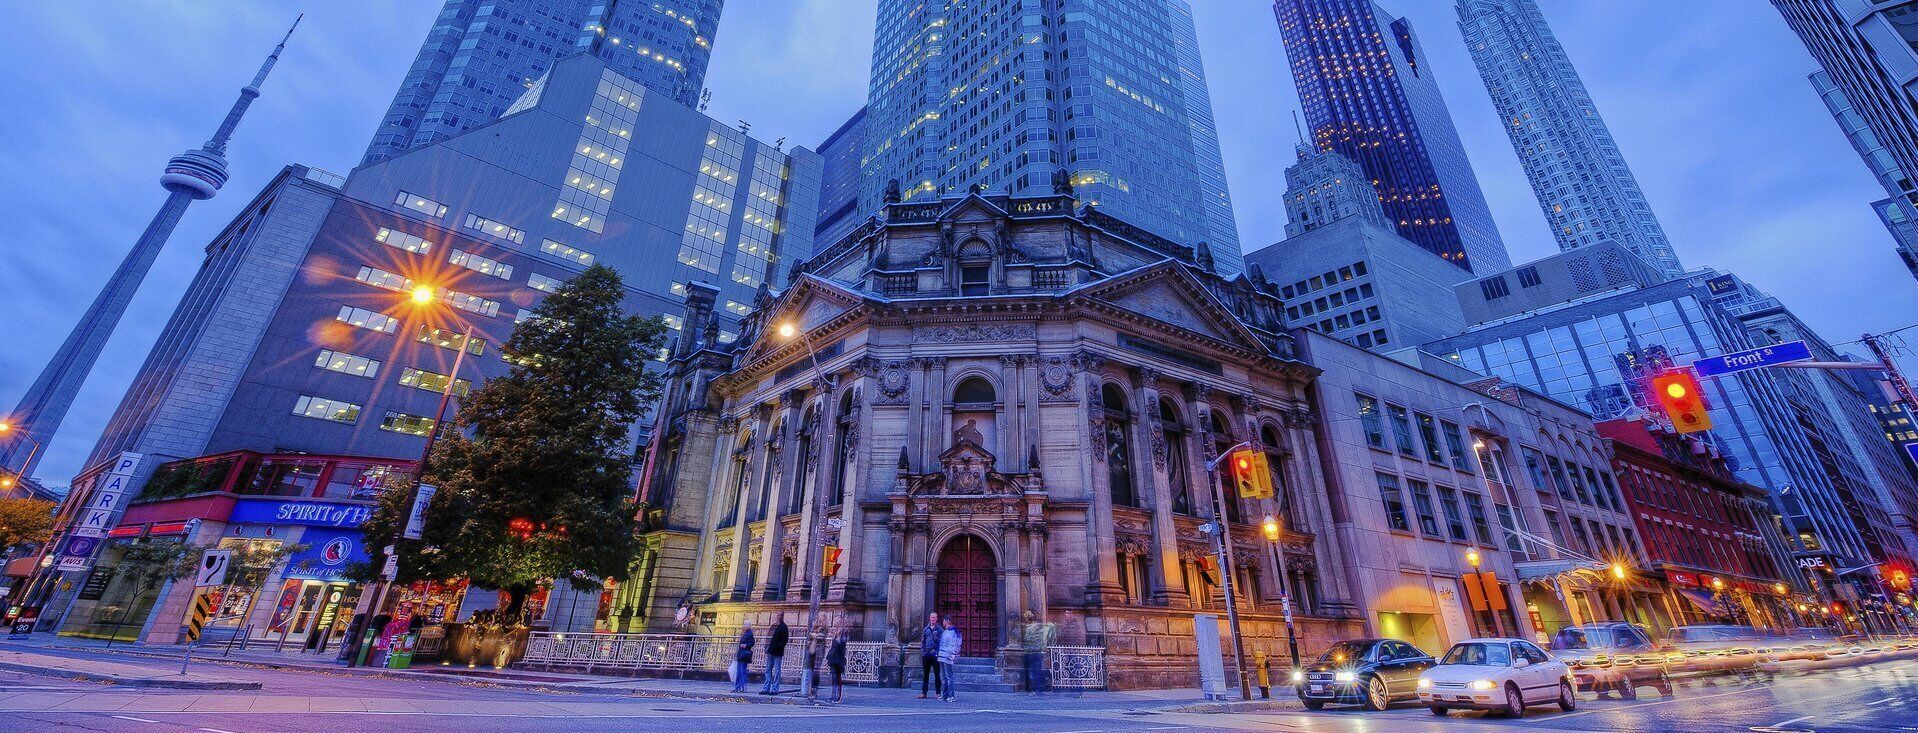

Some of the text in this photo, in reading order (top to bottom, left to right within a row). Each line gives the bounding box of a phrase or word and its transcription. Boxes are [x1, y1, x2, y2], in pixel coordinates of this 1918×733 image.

[1723, 348, 1774, 368] Front St
[89, 459, 133, 526] PARK
[277, 503, 335, 521] SPIRIT
[332, 506, 353, 526] of
[289, 566, 318, 575] SPIRIT
